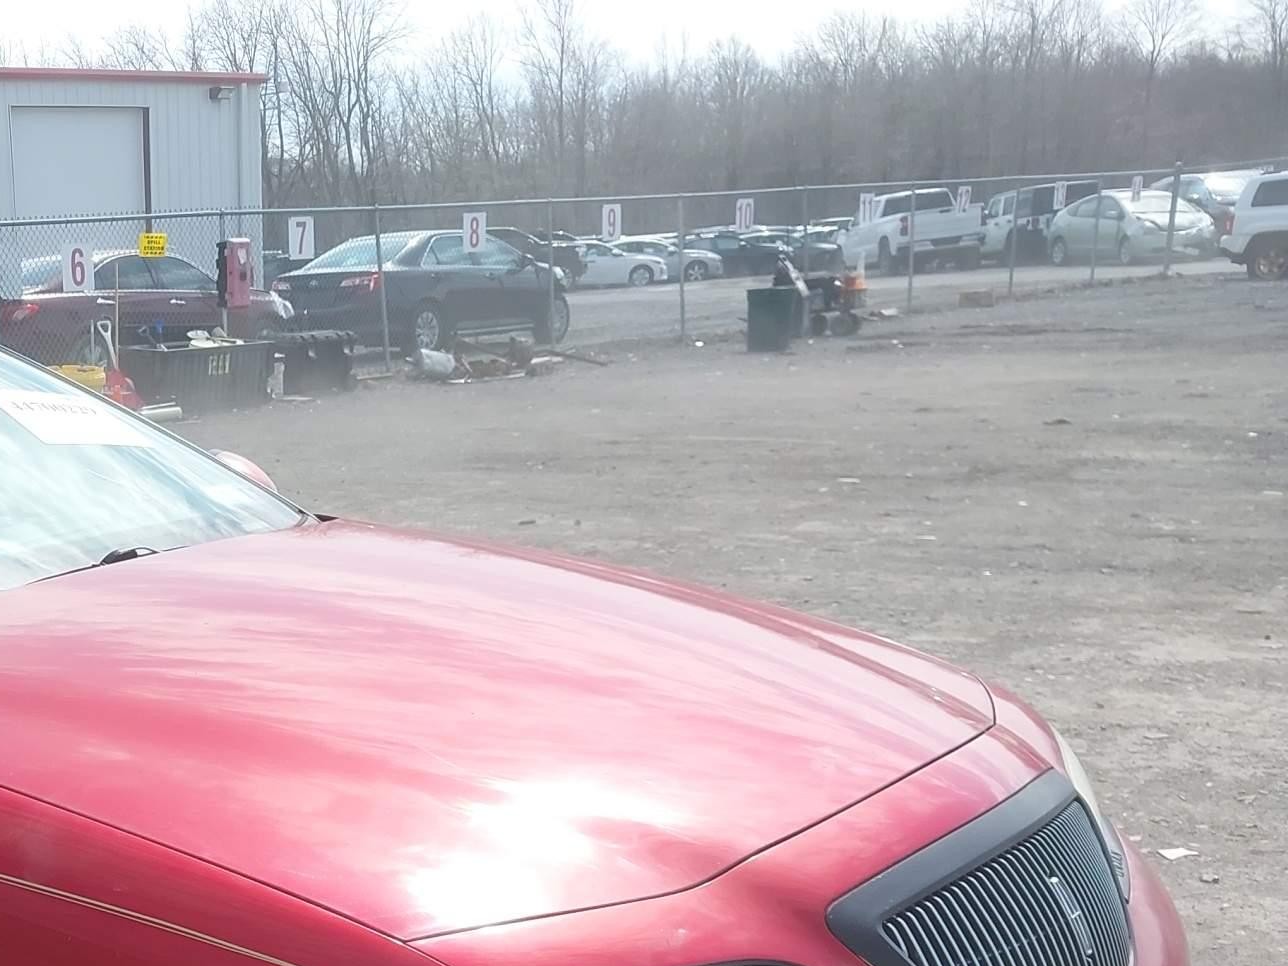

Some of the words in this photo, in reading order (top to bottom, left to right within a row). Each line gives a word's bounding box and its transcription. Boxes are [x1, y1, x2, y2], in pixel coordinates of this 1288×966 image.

[470, 216, 479, 249] 8
[608, 208, 616, 237] 9
[737, 202, 753, 231] 10
[295, 221, 307, 255] 7
[71, 247, 86, 287] 6
